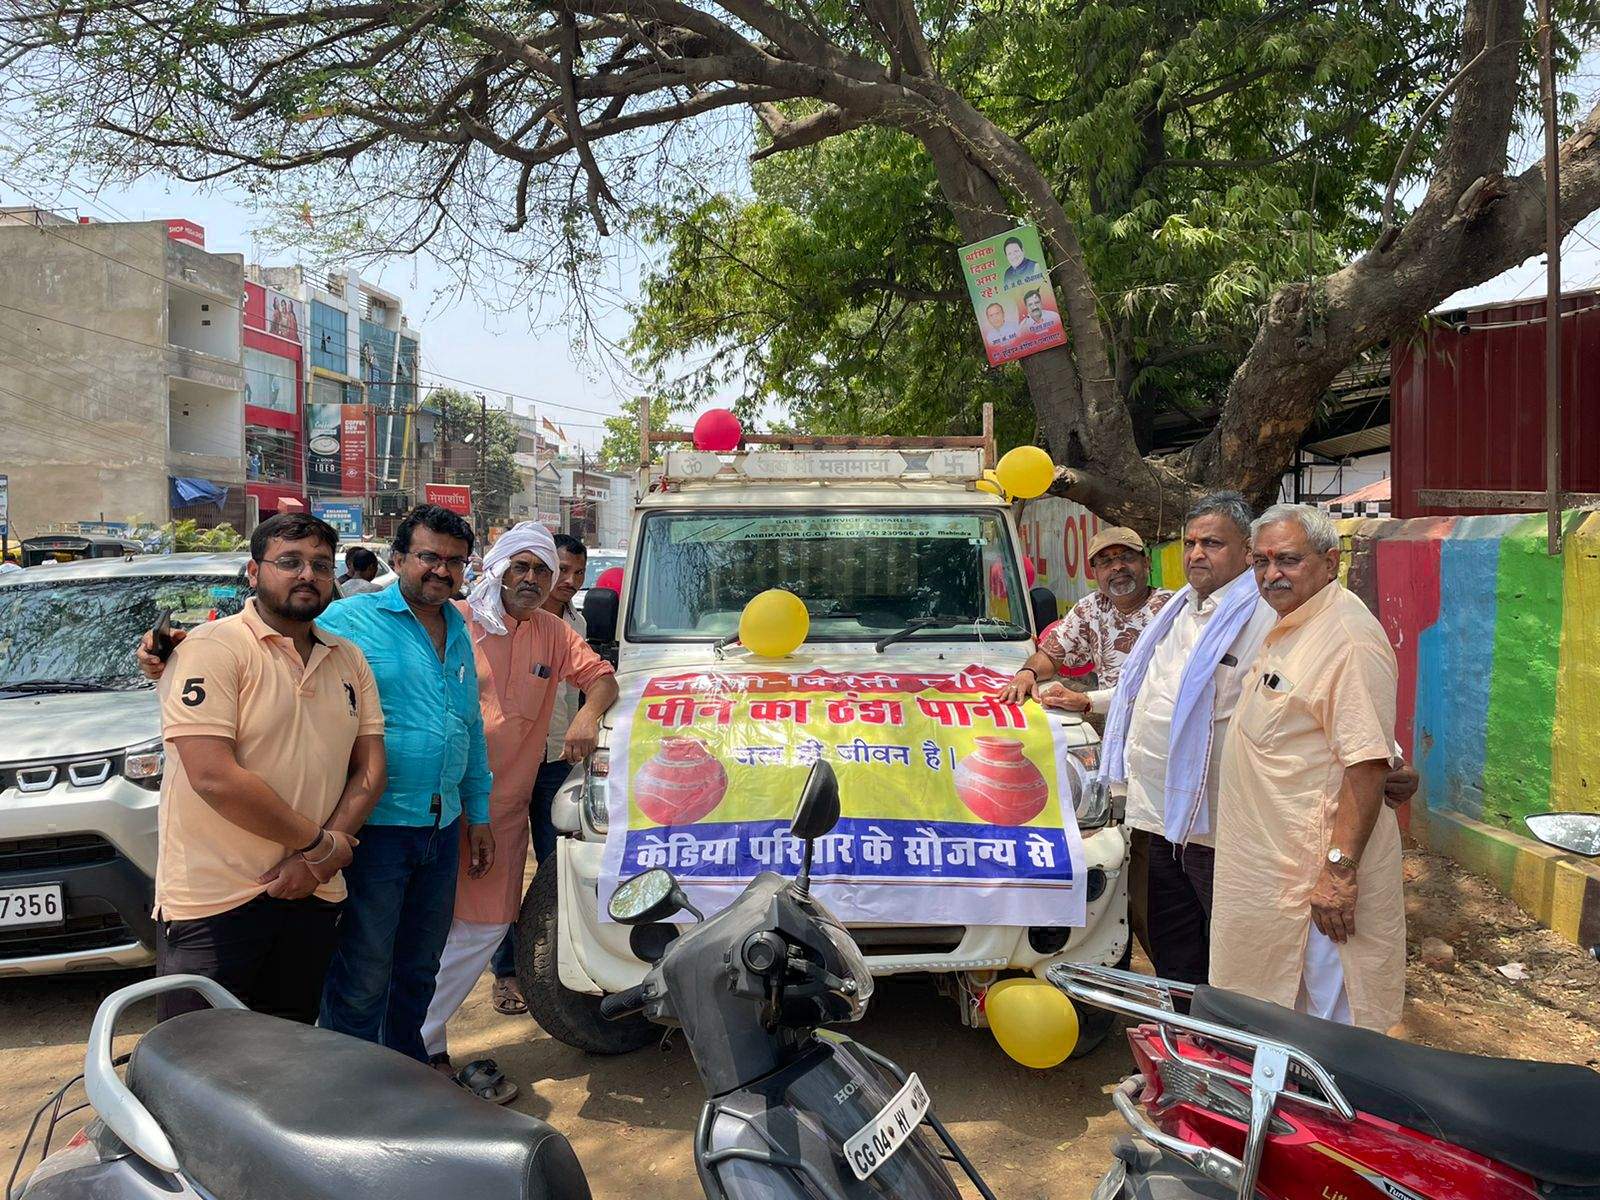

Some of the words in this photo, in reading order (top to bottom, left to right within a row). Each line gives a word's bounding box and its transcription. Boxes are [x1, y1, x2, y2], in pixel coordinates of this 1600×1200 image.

[819, 459, 890, 475] महामाया
[430, 491, 465, 504] मेगाशॉप
[744, 531, 801, 539] AMBIKAPUR
[181, 677, 206, 707] 5
[749, 699, 813, 726] का
[825, 691, 905, 727] ठंडा
[915, 695, 1028, 730] पानी
[836, 737, 911, 766] जीवन
[636, 832, 740, 869] केडिया
[861, 825, 894, 865] के
[903, 827, 1017, 867] सौजन्य
[1025, 832, 1056, 868] से
[0, 893, 58, 919] 7356
[853, 1142, 877, 1174] CG
[872, 1128, 893, 1157] 04
[894, 1107, 911, 1135] HY
